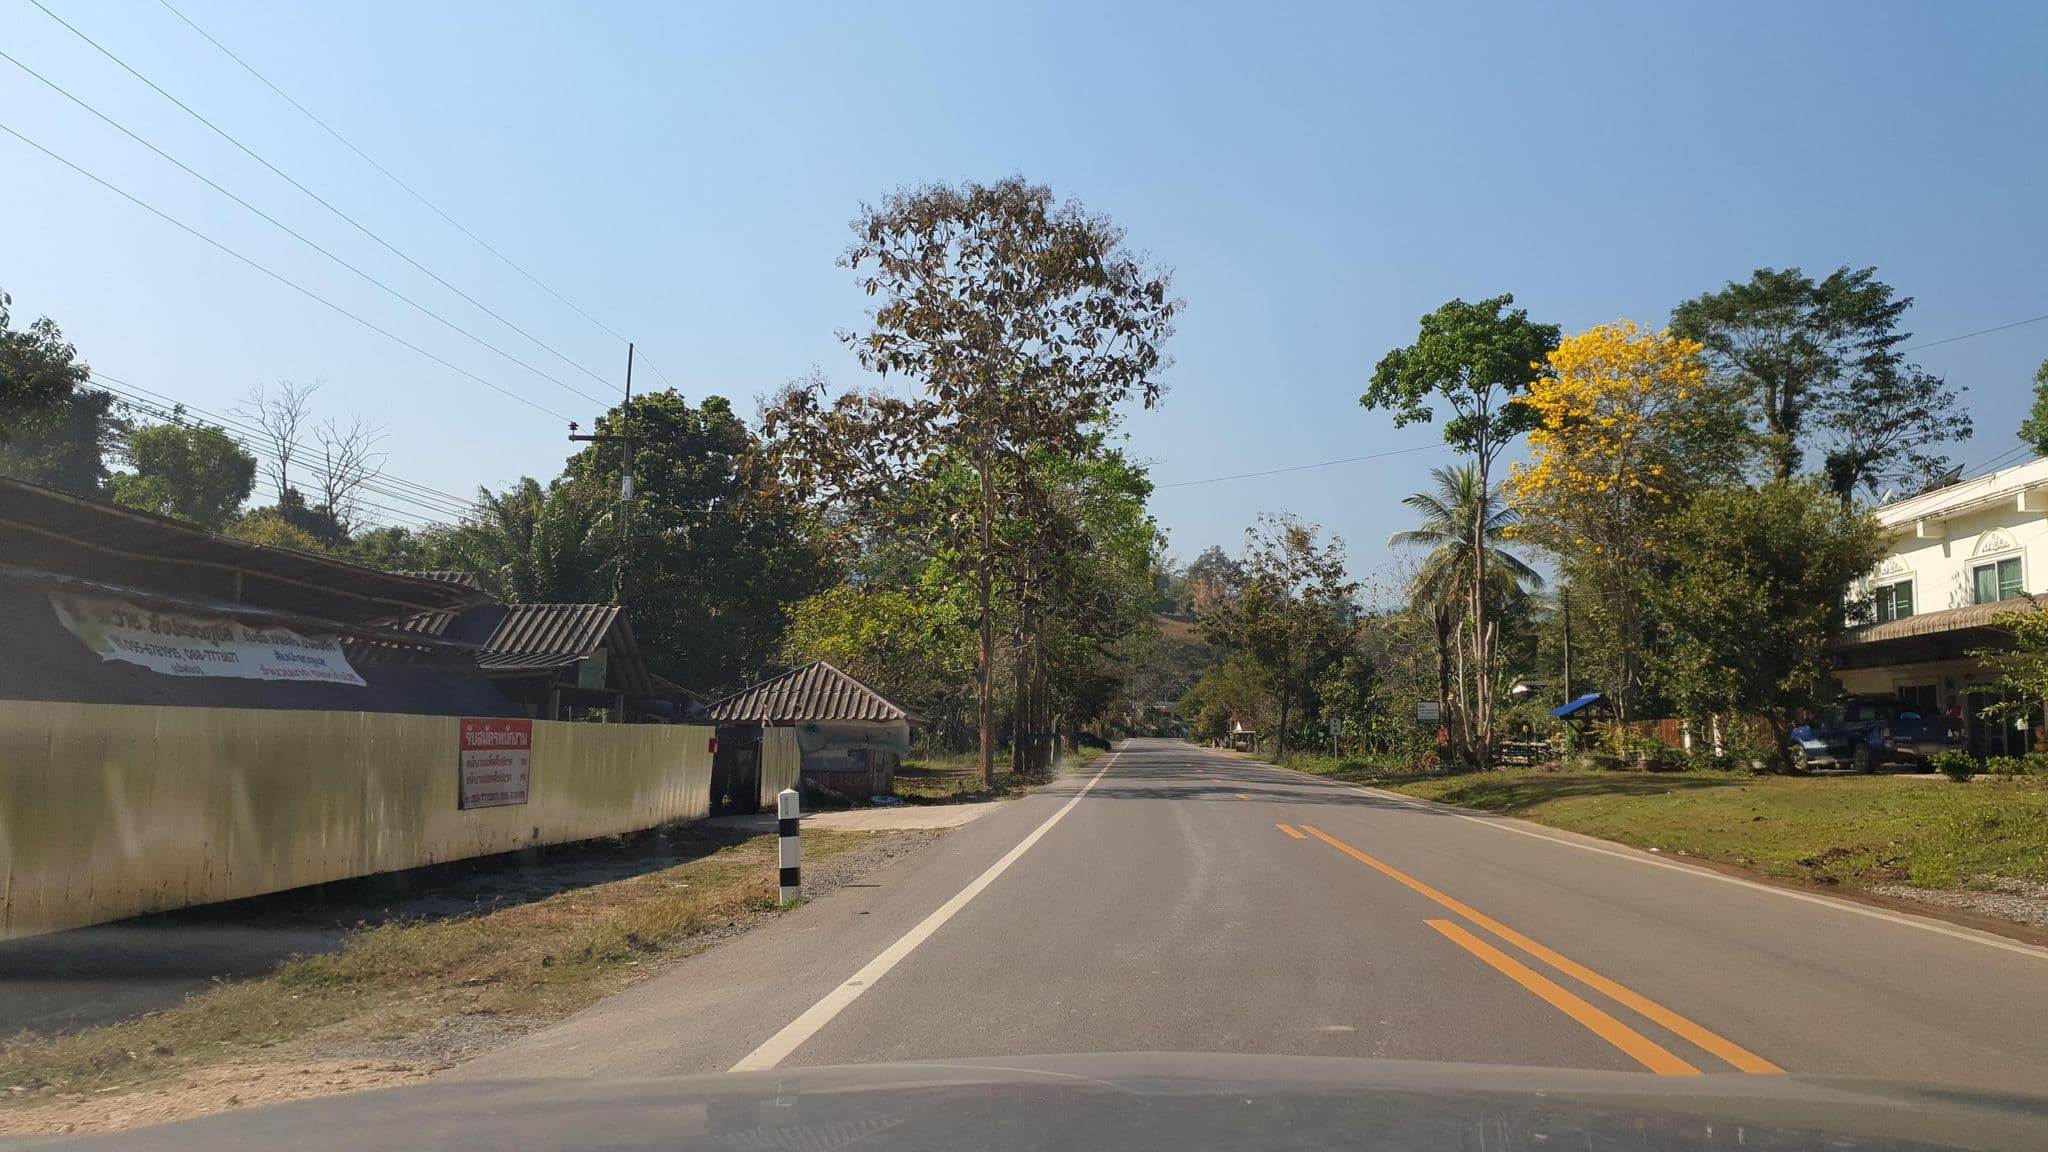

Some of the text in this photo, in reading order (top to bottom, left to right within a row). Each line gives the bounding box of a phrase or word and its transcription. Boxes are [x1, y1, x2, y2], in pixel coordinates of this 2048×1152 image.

[465, 724, 528, 746] รับสมัครพนักงาน
